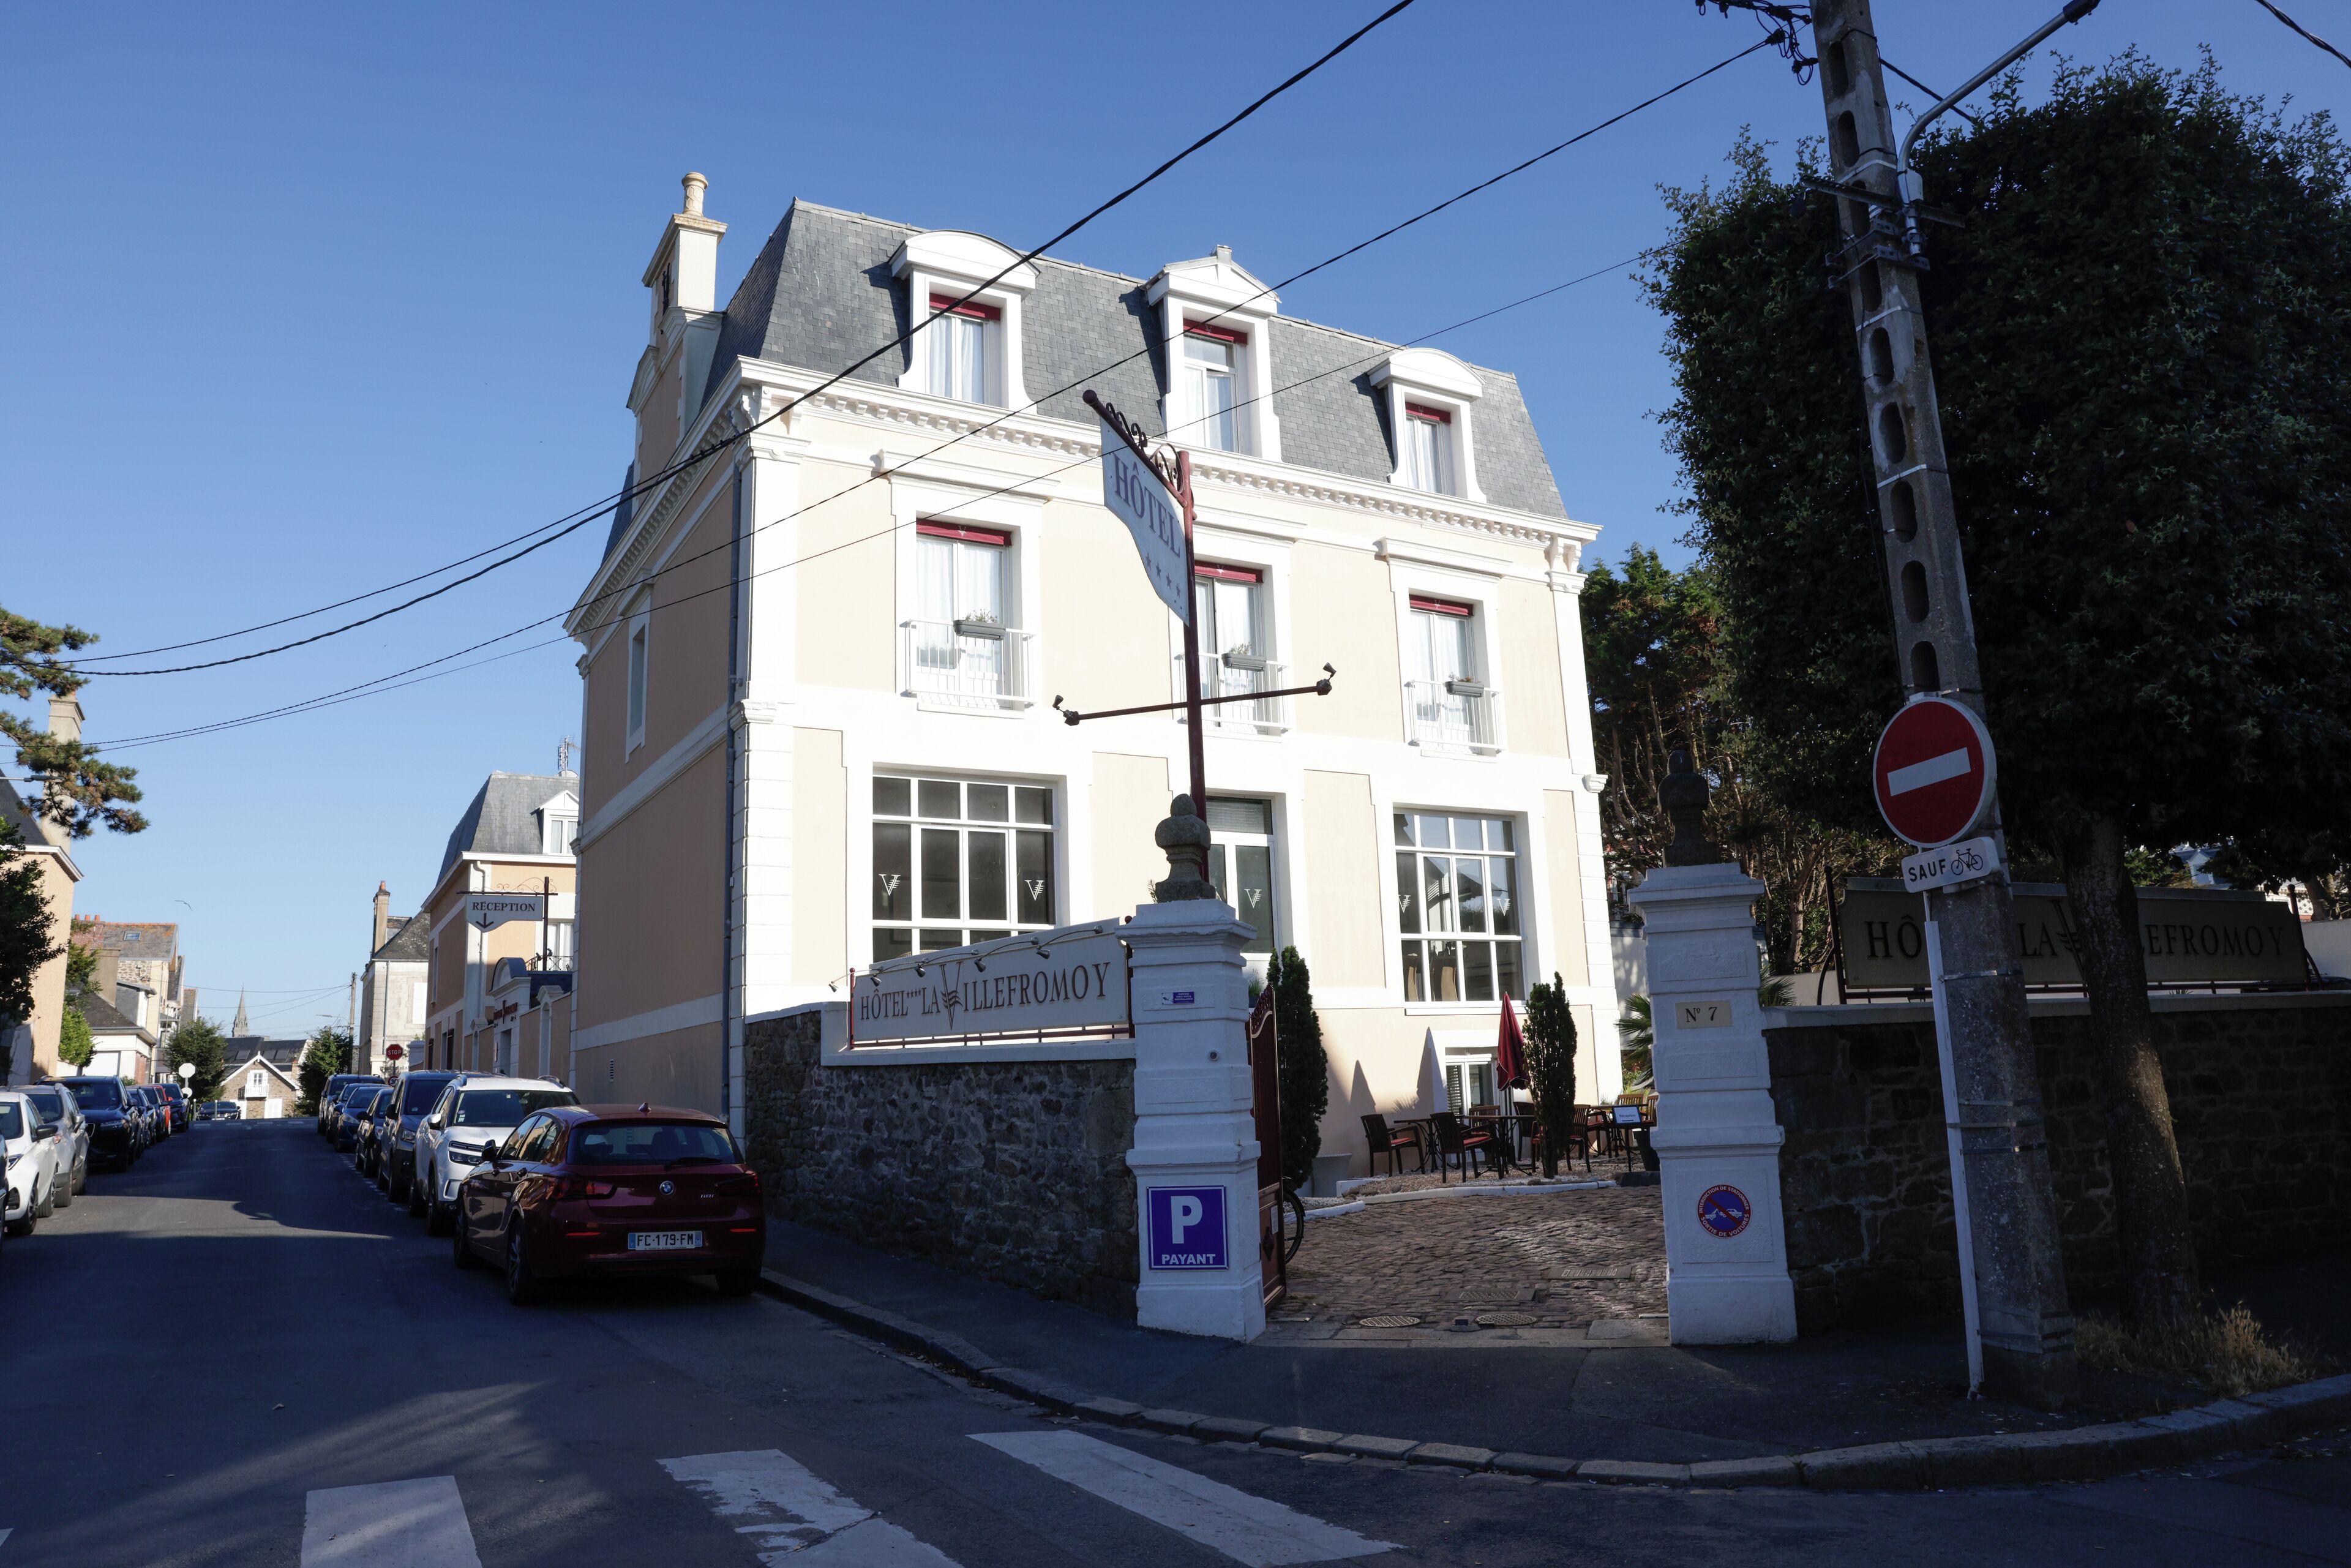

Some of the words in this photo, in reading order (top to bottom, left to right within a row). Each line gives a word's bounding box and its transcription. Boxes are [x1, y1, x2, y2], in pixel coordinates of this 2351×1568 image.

[1112, 452, 1180, 560] HÔTEL
[1908, 858, 1946, 882] SAUF
[2017, 921, 2058, 957] LA
[860, 989, 908, 1020] HÔTEL
[921, 986, 940, 1015] LA
[1709, 1007, 1718, 1021] 7
[1699, 1187, 1719, 1214] INTERDICTION
[1728, 1187, 1750, 1210] STATIONNER
[1170, 1195, 1203, 1244] P
[1700, 1217, 1717, 1235] SORTIE
[1728, 1214, 1750, 1236] VOITURES
[637, 1234, 694, 1247] FC-179-FM
[1161, 1253, 1216, 1264] PAYANT
